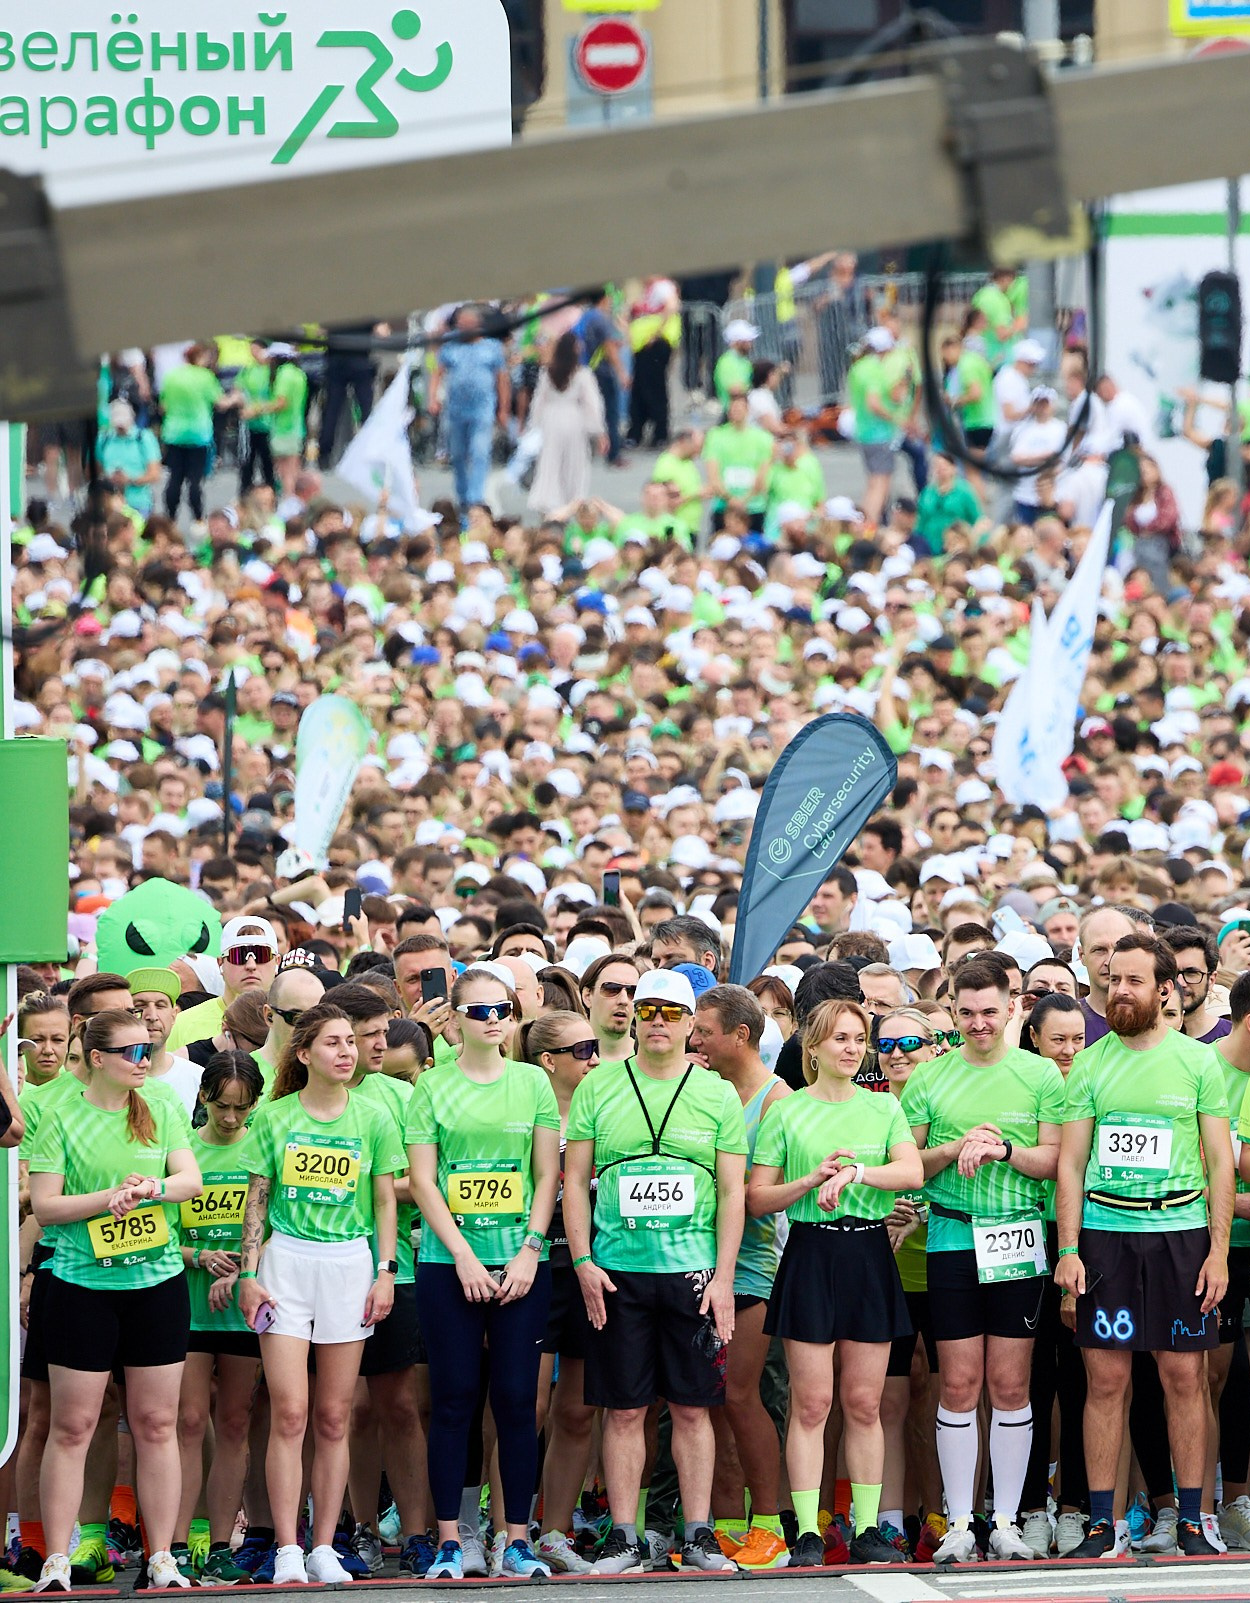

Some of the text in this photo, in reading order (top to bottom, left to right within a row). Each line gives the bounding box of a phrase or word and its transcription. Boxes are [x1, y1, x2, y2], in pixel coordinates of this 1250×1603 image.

[804, 747, 876, 850] Cybersecurity
[785, 786, 826, 841] SBER
[812, 830, 836, 859] Lab
[1108, 1132, 1159, 1155] 3391
[295, 1152, 350, 1177] 3200
[299, 1174, 343, 1185] МИРОСЛАВА
[459, 1179, 512, 1200] 5796
[192, 1191, 246, 1213] 5647
[629, 1182, 684, 1202] 4456
[198, 1212, 240, 1221] АНАСТАСИЯ
[642, 1203, 672, 1211] АНДРЕЙ
[100, 1214, 156, 1244] 5785
[111, 1237, 153, 1251] ЕКАТЕРИНА
[985, 1228, 1035, 1254] 2370
[1002, 1251, 1025, 1260] ДЕНИС
[1094, 1309, 1134, 1342] 88
